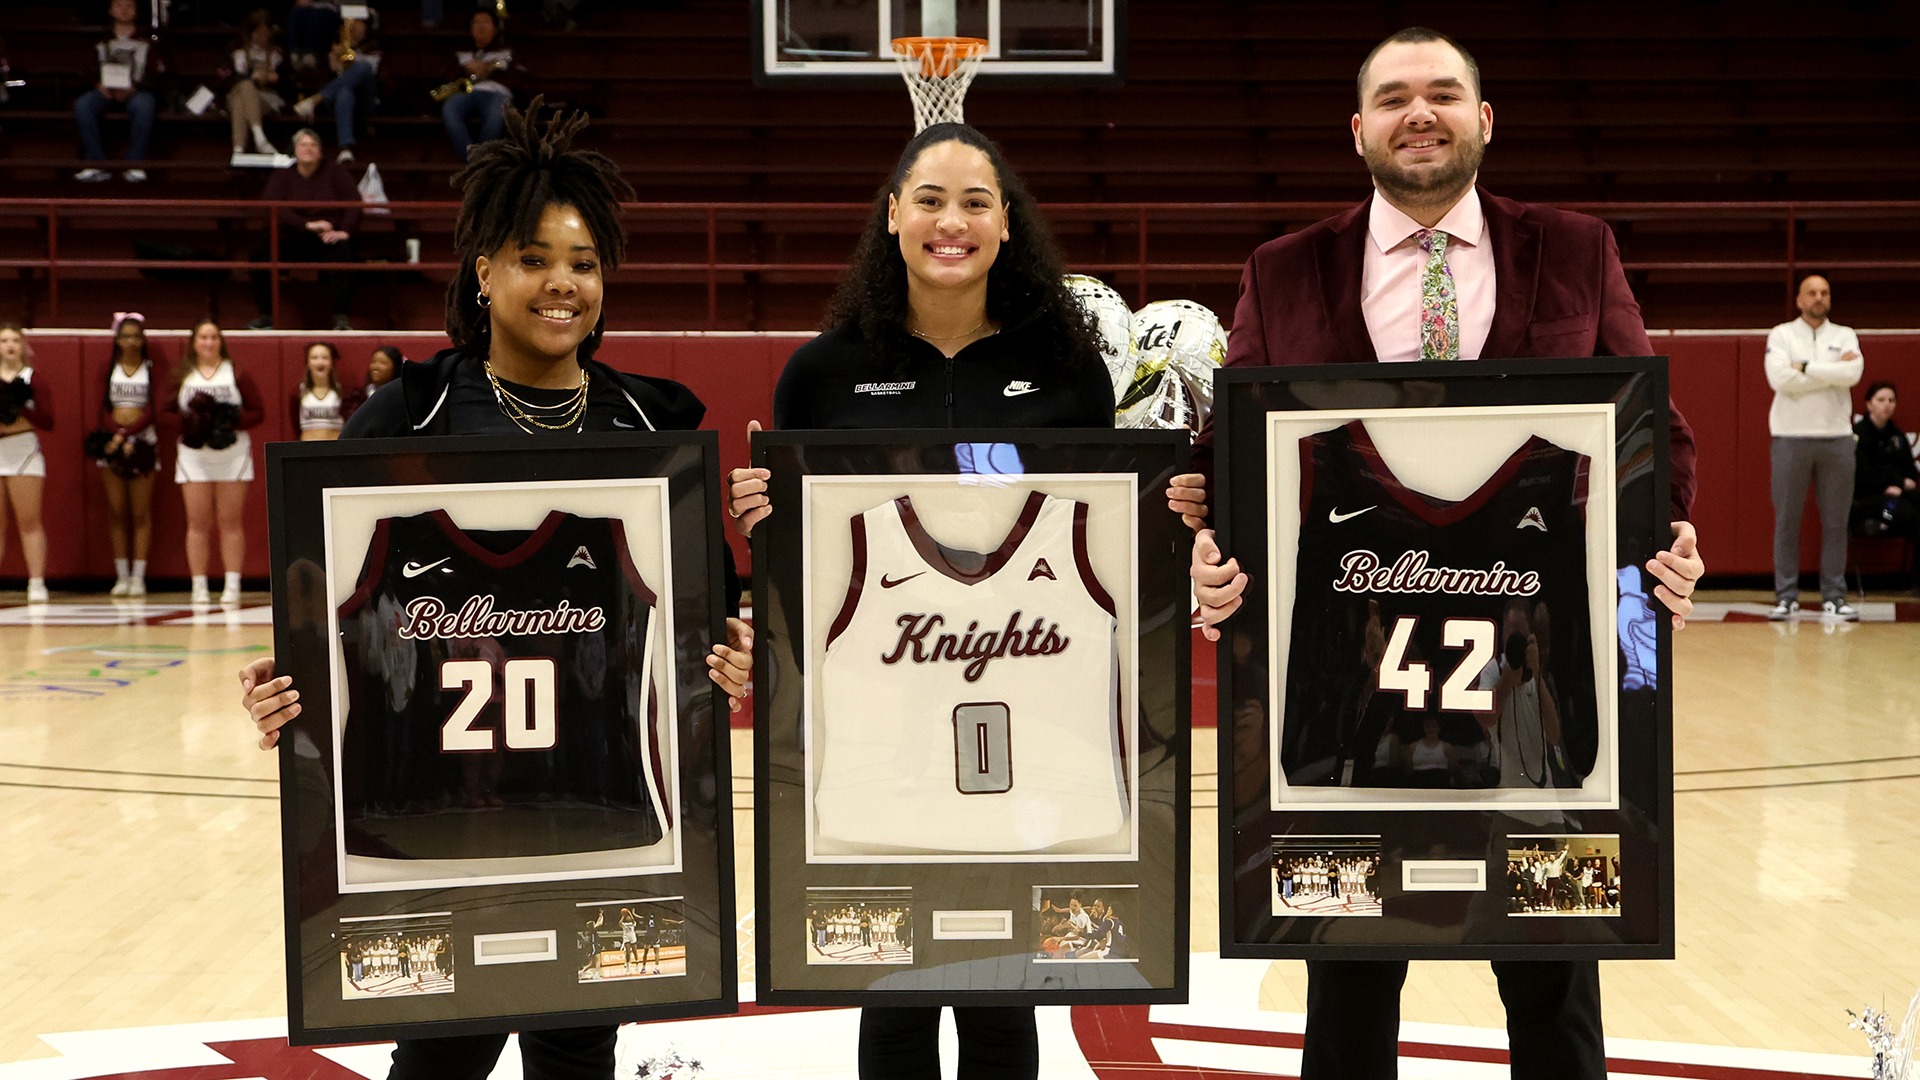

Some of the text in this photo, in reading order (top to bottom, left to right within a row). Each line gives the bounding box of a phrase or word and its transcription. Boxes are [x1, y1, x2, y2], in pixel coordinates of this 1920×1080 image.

[854, 381, 916, 393] BELLARMINE
[1009, 381, 1032, 391] NIKE
[1333, 550, 1540, 596] Bellarmine
[398, 595, 605, 640] Bellarmine
[880, 609, 1071, 683] Knights
[1378, 615, 1497, 713] 42
[440, 657, 558, 753] 20
[953, 702, 1013, 795] 0
